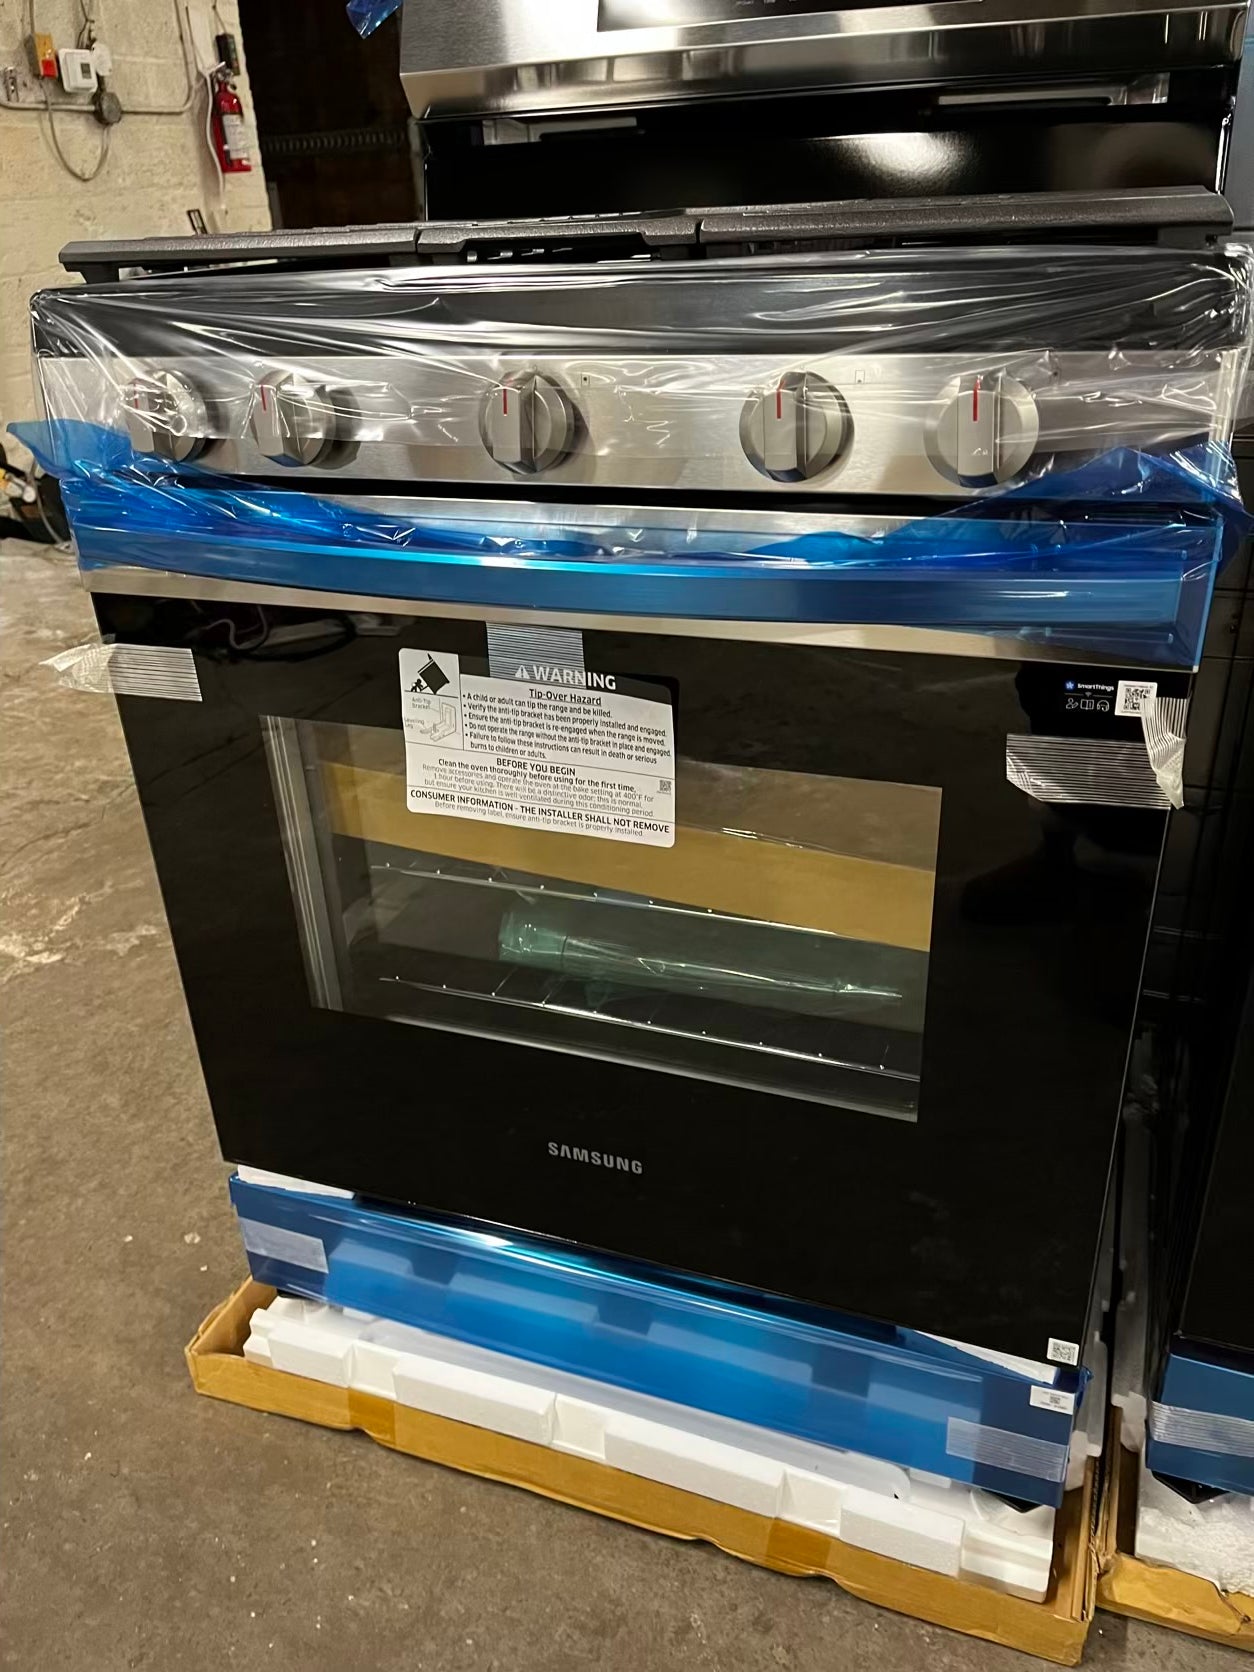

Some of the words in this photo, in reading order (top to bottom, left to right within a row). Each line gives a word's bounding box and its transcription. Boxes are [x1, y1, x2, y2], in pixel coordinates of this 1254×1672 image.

[533, 665, 616, 690] WARNING
[1078, 683, 1114, 691] SmartThings
[529, 689, 567, 701] Tip-Over
[570, 694, 601, 705] Hazard
[468, 703, 486, 711] Verify
[498, 707, 519, 716] anti-tip
[521, 711, 542, 720] bracket
[572, 717, 598, 727] properly
[600, 720, 625, 730] installed
[640, 726, 666, 737] engaged.
[549, 705, 567, 713] range
[593, 709, 612, 718] killed.
[469, 713, 488, 721] Ensure
[500, 717, 521, 727] anti-tip
[523, 720, 545, 730] bracket
[553, 724, 587, 736] re-engaged
[589, 728, 605, 737] when
[618, 733, 635, 742] range
[644, 737, 665, 746] moved.
[488, 725, 508, 734] operate
[509, 727, 518, 735] the
[519, 730, 534, 739] range
[536, 732, 556, 741] without
[568, 736, 589, 745] anti-tip
[590, 738, 611, 747] bracket
[619, 742, 633, 751] place
[647, 747, 671, 757] engaged.
[470, 732, 489, 741] Failure
[498, 735, 516, 744] follow
[517, 738, 533, 746] these
[534, 740, 569, 752] instructions
[582, 748, 600, 756] result
[608, 750, 625, 759] death
[635, 754, 657, 764] serious
[496, 745, 518, 754] children
[528, 750, 546, 759] adults.
[423, 764, 447, 774] Remove
[449, 768, 482, 778] accessories
[498, 774, 521, 784] operate
[535, 780, 552, 788] oven
[591, 788, 612, 797] setting
[439, 759, 456, 768] Clean
[490, 765, 527, 779] thoroughly
[529, 771, 552, 781] before
[554, 776, 573, 784] using
[497, 758, 527, 770] BEFORE
[530, 763, 548, 773] YOU
[550, 766, 575, 776] BEGIN
[455, 776, 474, 784] before
[497, 780, 513, 790] There
[543, 789, 577, 800] distinctive
[474, 786, 496, 795] kitchen
[520, 793, 551, 803] ventilated
[553, 798, 574, 806] during
[590, 802, 630, 814] conditioning
[411, 790, 455, 802] CONSUMER
[458, 796, 513, 811] INFORMATION
[520, 806, 535, 815] THE
[538, 808, 582, 820] INSTALLER
[585, 814, 610, 824] SHALL
[614, 818, 631, 827] NOT
[634, 821, 669, 833] REMOVE
[435, 801, 455, 809] Before
[457, 804, 486, 815] removing
[506, 812, 526, 820] ensure
[528, 816, 551, 824] anti-tip
[553, 818, 577, 827] bracket
[585, 823, 613, 833] properly
[548, 1142, 643, 1174] SAMSUNG
